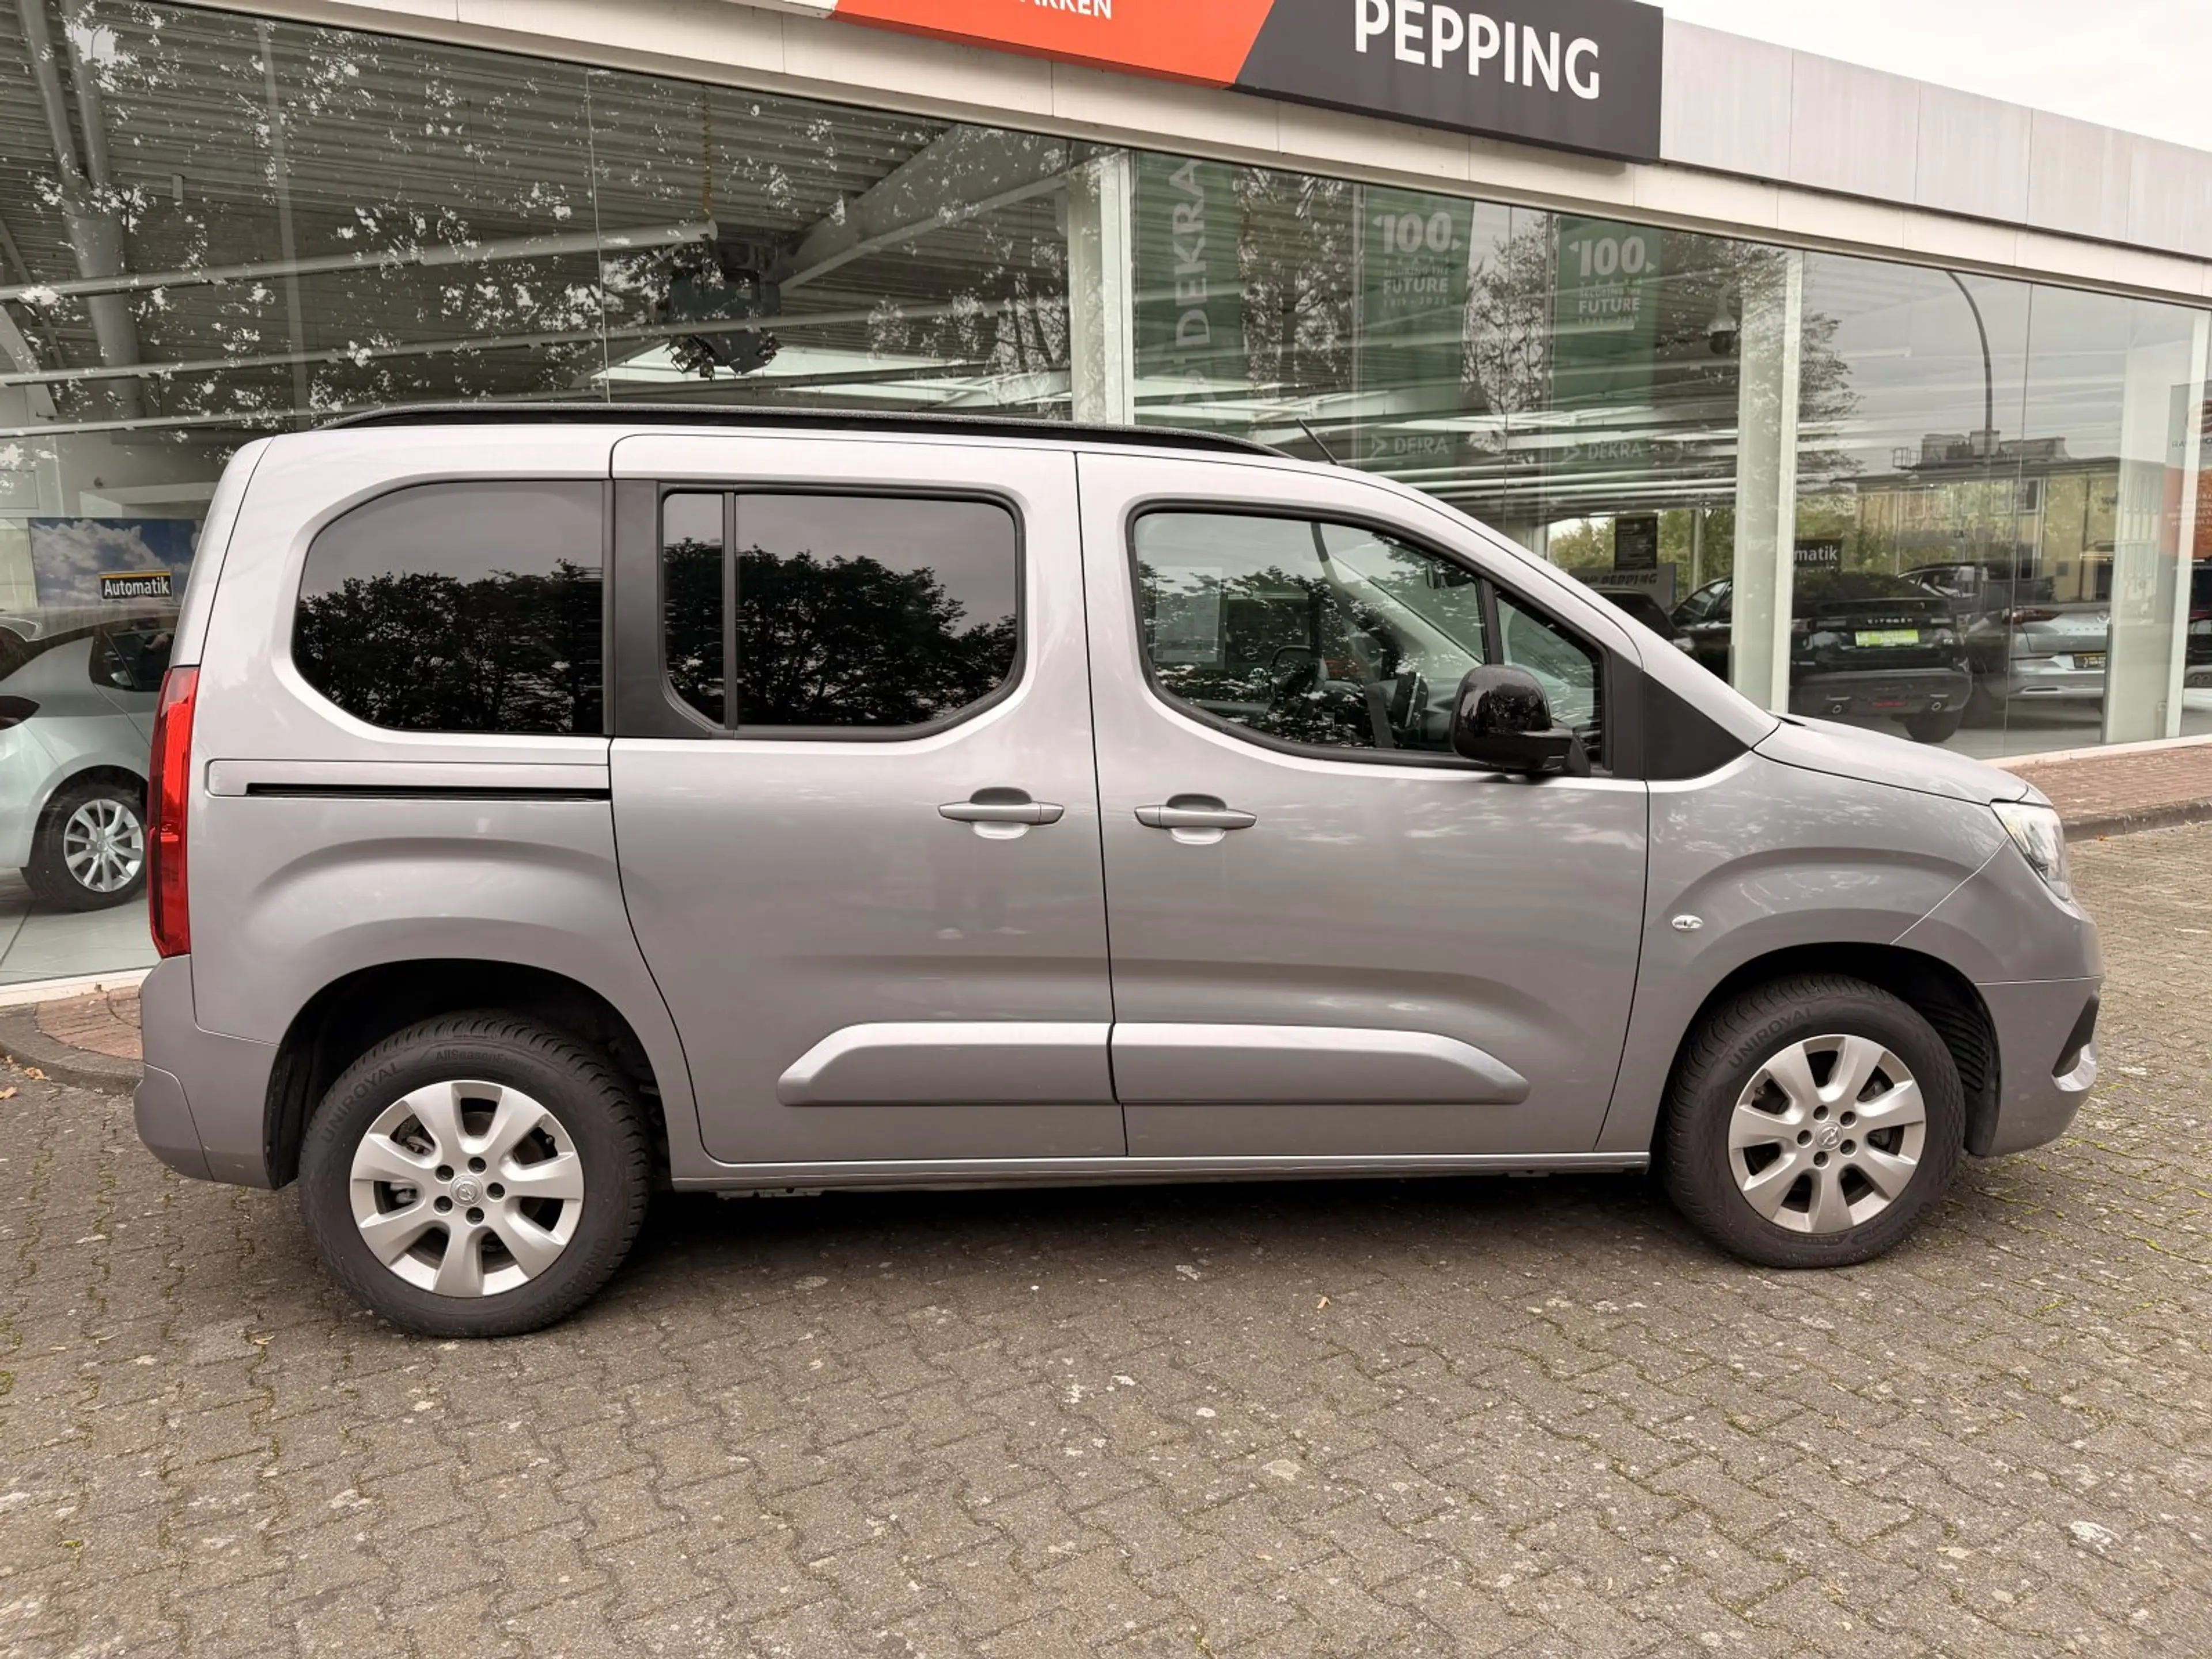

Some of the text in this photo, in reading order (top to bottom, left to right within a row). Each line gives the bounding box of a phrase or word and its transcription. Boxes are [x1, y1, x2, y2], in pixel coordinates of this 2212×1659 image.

[1355, 0, 1600, 100] PEPPING
[1169, 158, 1210, 347] DEKRA
[1383, 211, 1452, 254] 100
[1580, 236, 1646, 276] 100
[1384, 276, 1449, 296] FUTURE
[1579, 297, 1641, 314] FUTURE
[1588, 442, 1643, 460] DEKRA
[104, 577, 170, 596] Automatik
[1729, 1007, 1812, 1068] UNIROYAL
[320, 1062, 404, 1143] UNIROYAL
